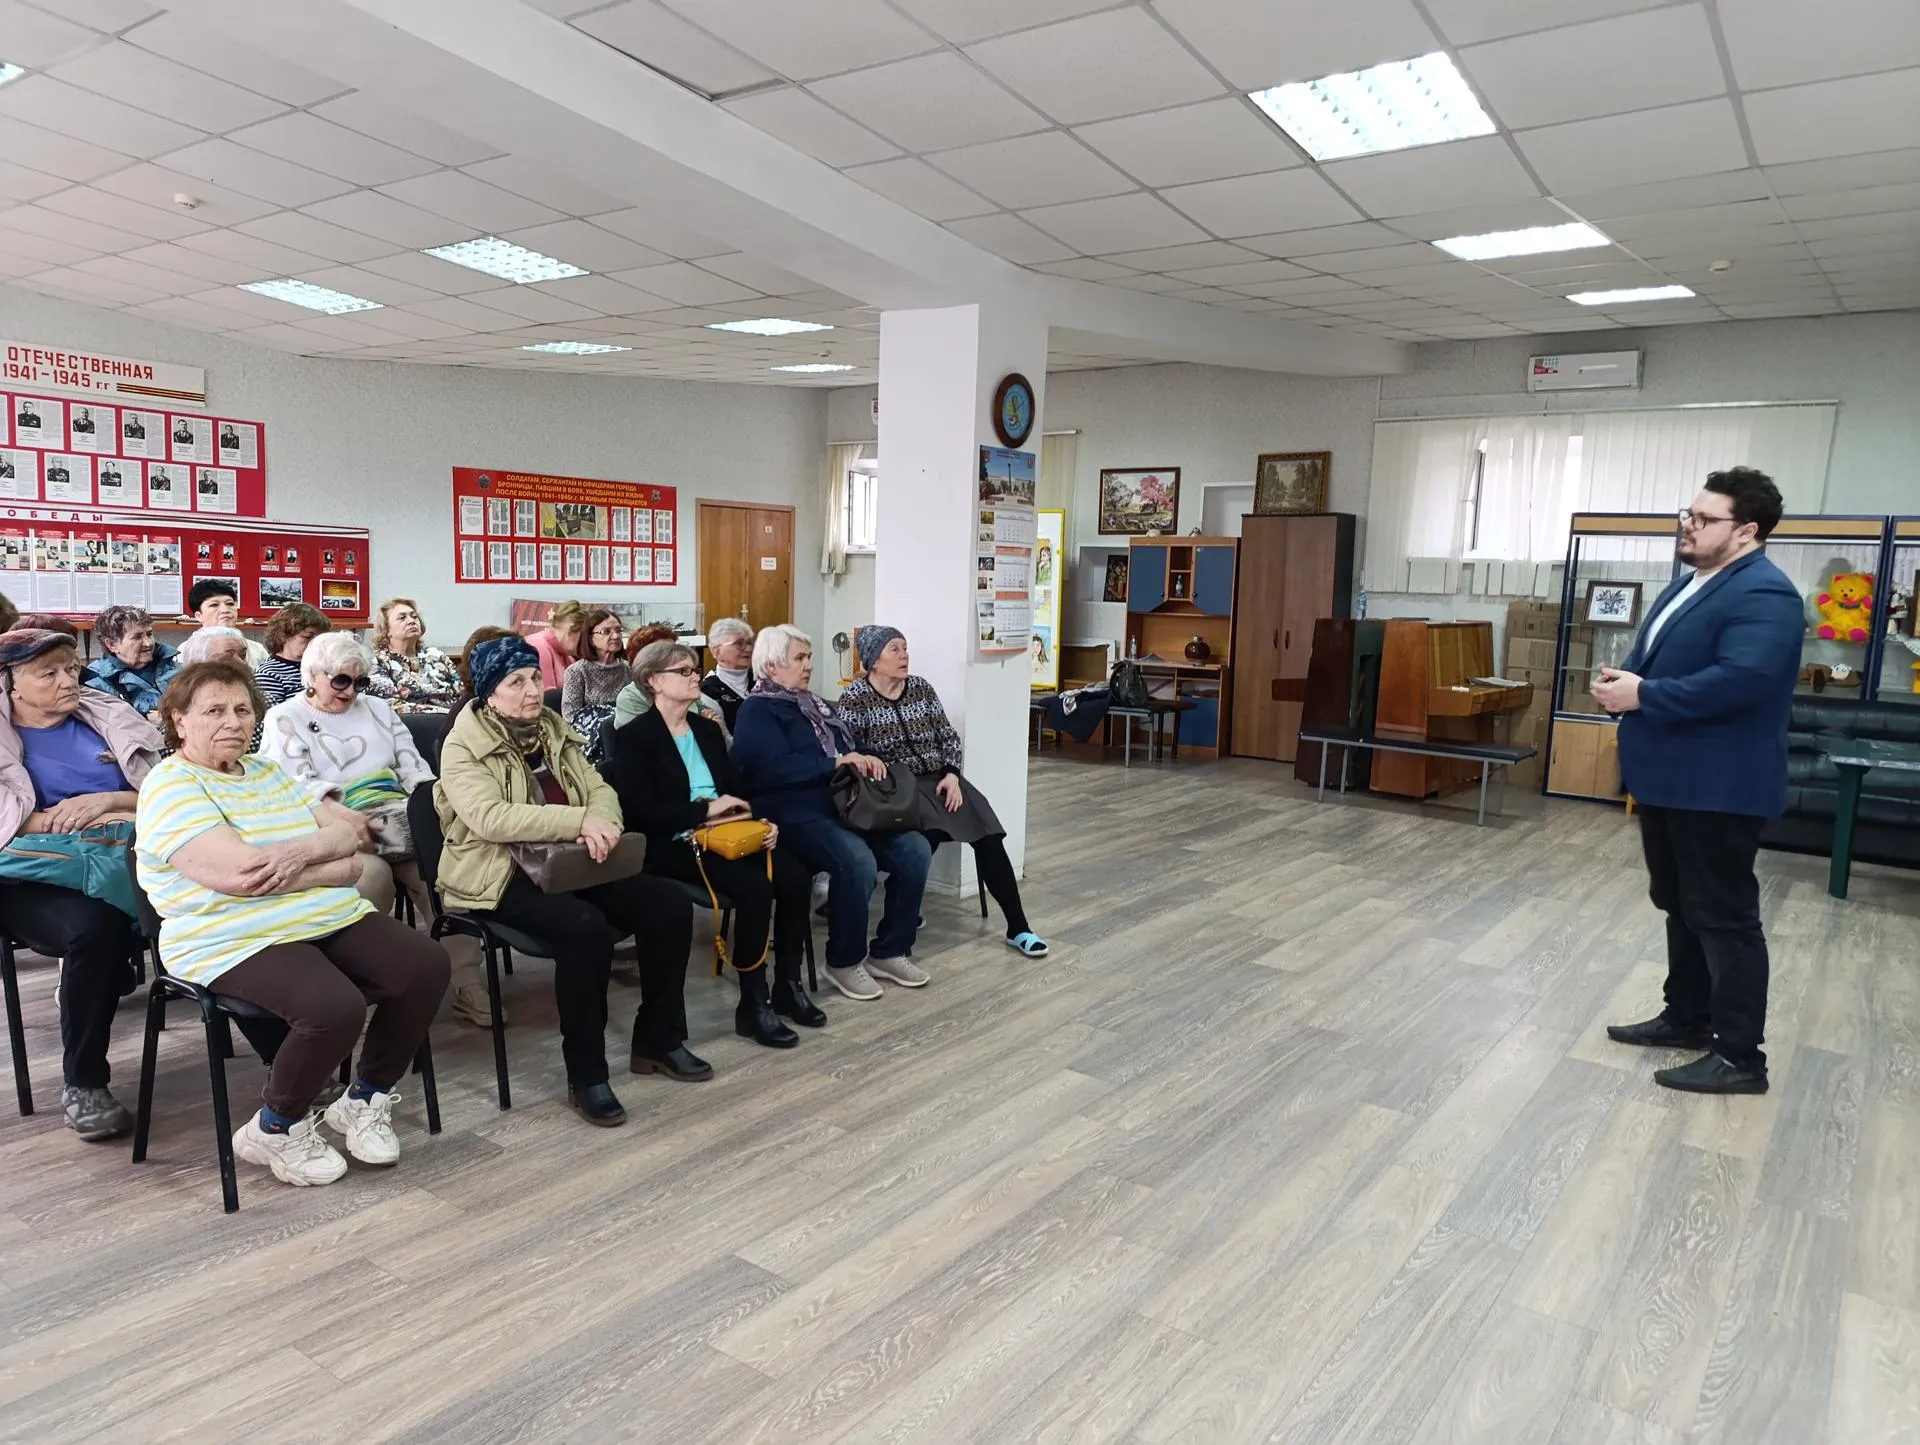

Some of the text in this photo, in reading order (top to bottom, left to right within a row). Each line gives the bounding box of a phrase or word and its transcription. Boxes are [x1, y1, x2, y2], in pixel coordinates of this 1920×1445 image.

[8, 346, 153, 380] ОТЕЧЕСТВЕННАЯ
[542, 478, 577, 486] СЕРЖАНТАМ
[583, 482, 614, 490] ОФИЦЕРАМ
[496, 488, 518, 496] ПОСЛЕ
[586, 488, 616, 496] УШЕДШИМ
